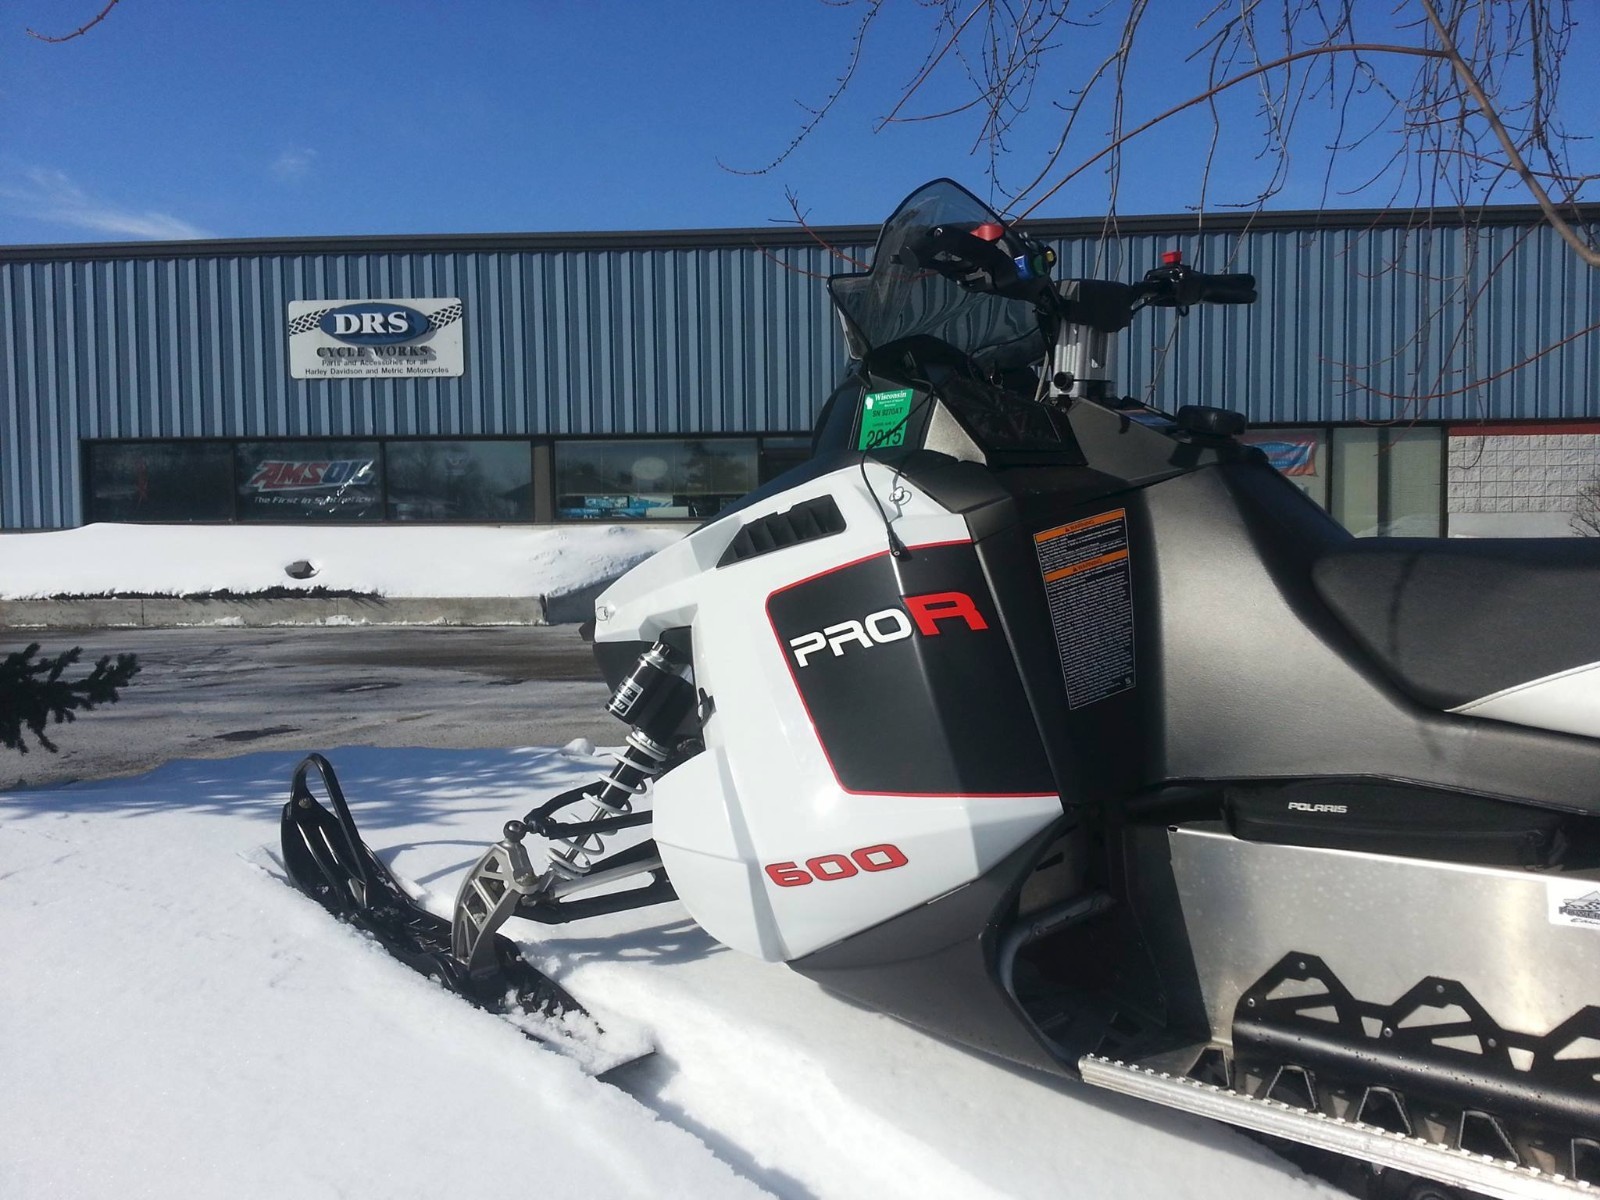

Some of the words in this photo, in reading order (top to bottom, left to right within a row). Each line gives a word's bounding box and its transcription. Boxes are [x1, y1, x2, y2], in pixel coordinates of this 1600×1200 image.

[333, 311, 409, 335] DRS
[316, 346, 365, 358] CYCLE
[374, 345, 429, 358] WORKS
[321, 359, 341, 367] Parts
[305, 368, 327, 376] Harley
[875, 391, 907, 400] Wisconsin
[867, 427, 902, 449] 2015
[250, 459, 375, 492] AMSOIL
[1287, 801, 1348, 814] POLARIS
[764, 843, 909, 888] 600
